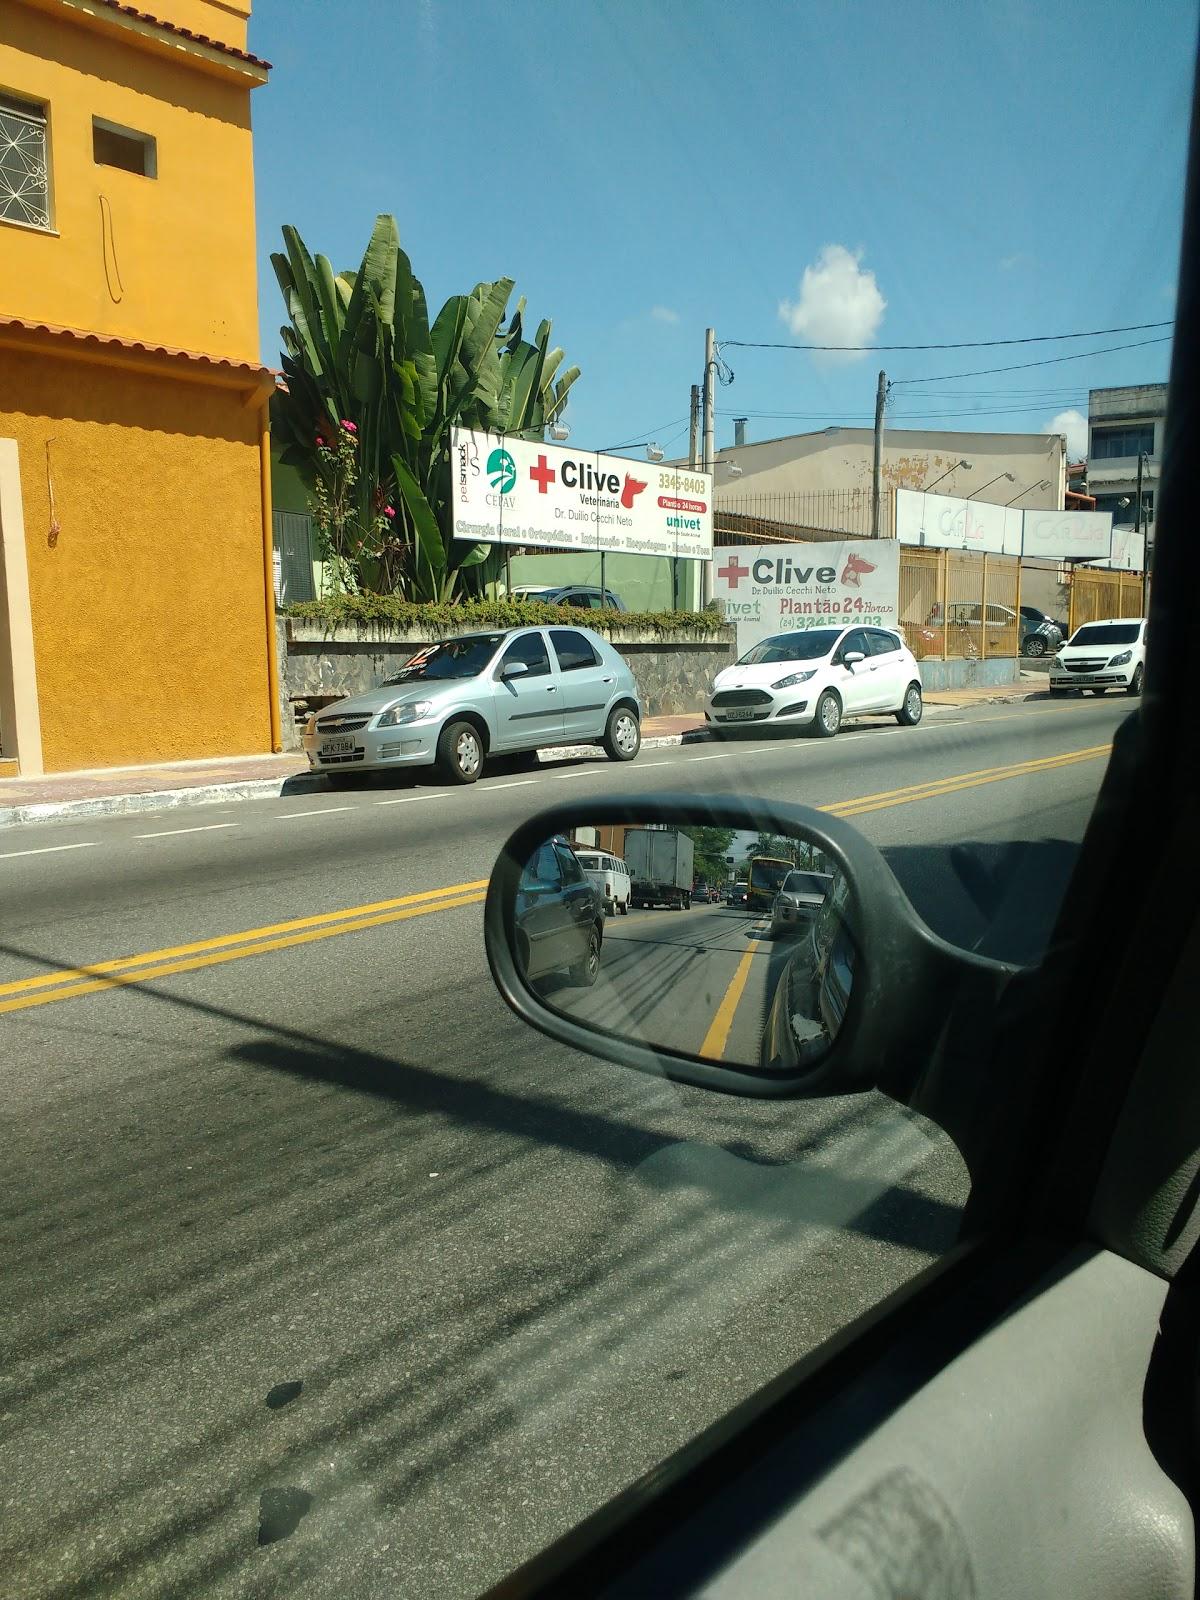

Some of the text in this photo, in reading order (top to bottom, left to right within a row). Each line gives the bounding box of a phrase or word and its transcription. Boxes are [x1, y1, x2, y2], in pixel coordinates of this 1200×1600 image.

[560, 460, 621, 493] Clive
[682, 501, 688, 509] 24
[554, 507, 567, 519] Dr.
[616, 514, 633, 526] Neto
[666, 515, 701, 530] univet
[752, 558, 837, 584] Clive
[815, 585, 837, 594] Neto
[779, 597, 894, 614] Plantão 24 Horas
